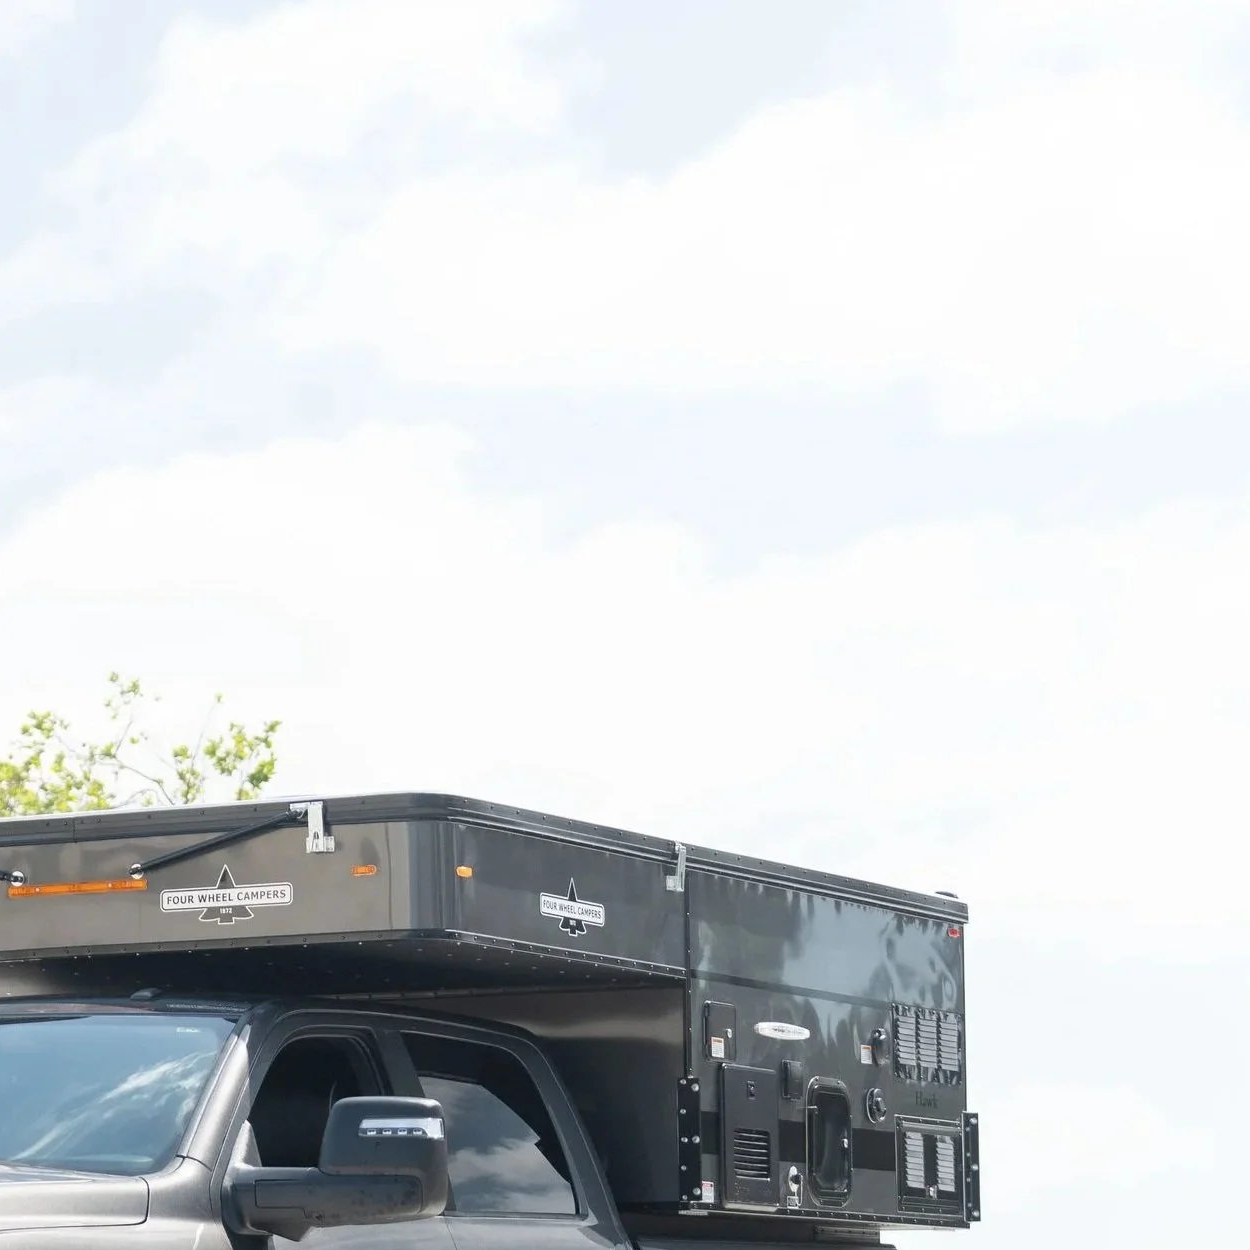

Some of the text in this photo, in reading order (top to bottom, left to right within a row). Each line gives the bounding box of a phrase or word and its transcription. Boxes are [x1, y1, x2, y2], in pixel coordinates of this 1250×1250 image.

[167, 889, 286, 905] FOUR WHEEL CAMPERS
[542, 899, 602, 919] FOUR WHEEL CAMPERS
